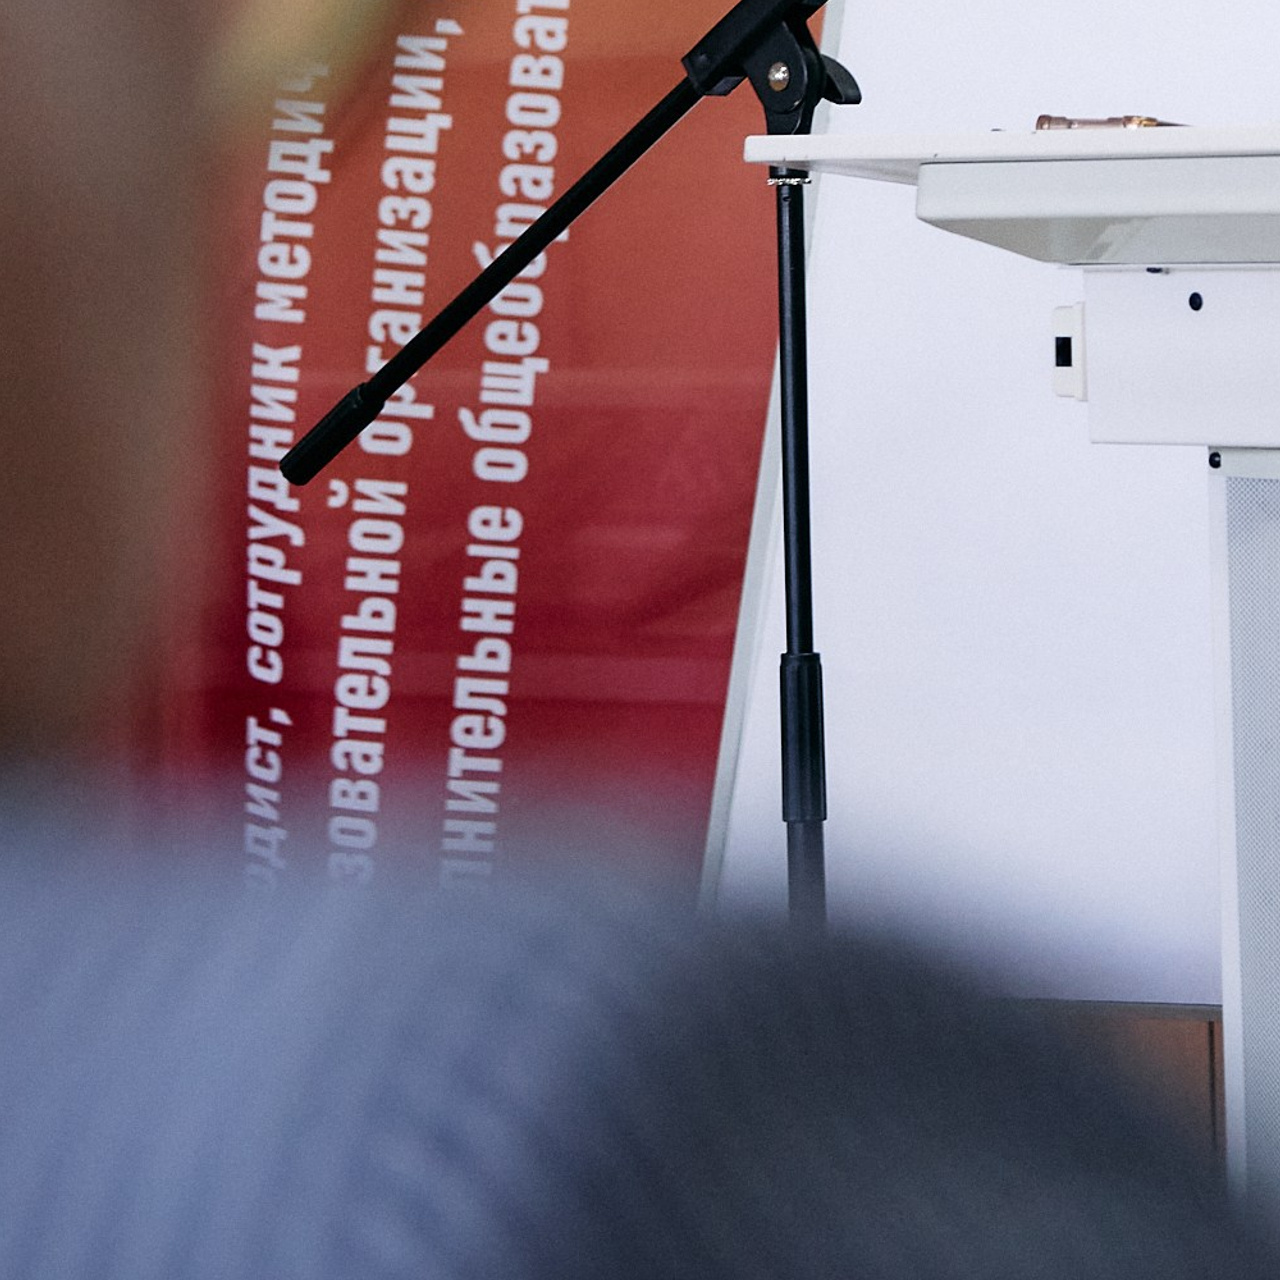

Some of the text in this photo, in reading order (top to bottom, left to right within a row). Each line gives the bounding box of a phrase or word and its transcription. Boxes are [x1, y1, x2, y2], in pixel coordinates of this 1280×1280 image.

[358, 18, 465, 456] организации,
[247, 342, 306, 685] сотрудник
[326, 478, 409, 882] зовательной
[244, 707, 294, 873] дист,
